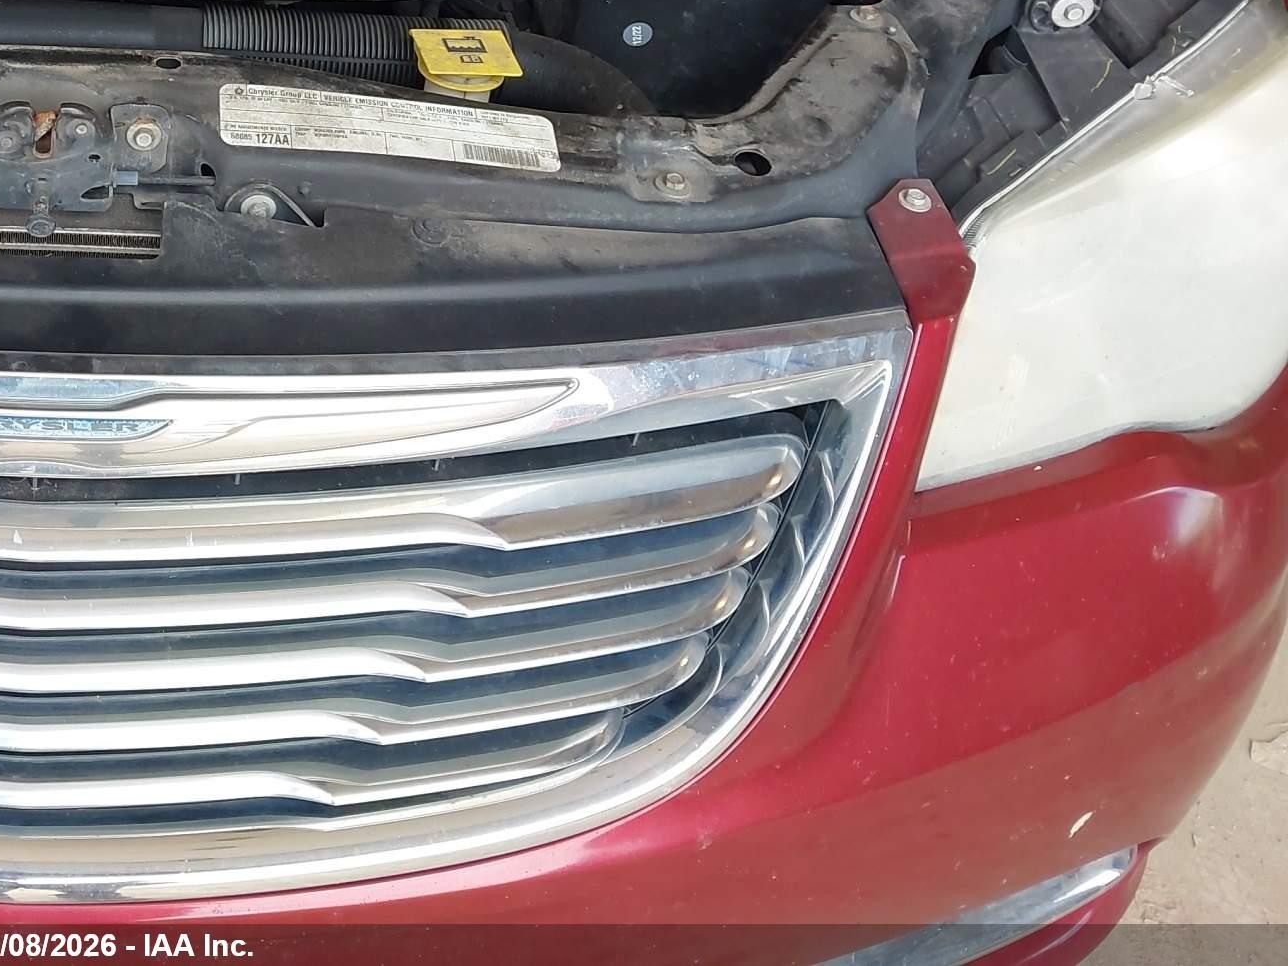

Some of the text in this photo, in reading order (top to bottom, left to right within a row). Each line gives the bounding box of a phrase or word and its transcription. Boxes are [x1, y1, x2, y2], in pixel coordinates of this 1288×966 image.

[632, 25, 643, 45] 12/22
[248, 88, 318, 100] Chrysler Group LLC
[355, 97, 389, 107] EMISSION
[425, 105, 474, 117] INFORMATION
[255, 133, 290, 145] 127AA
